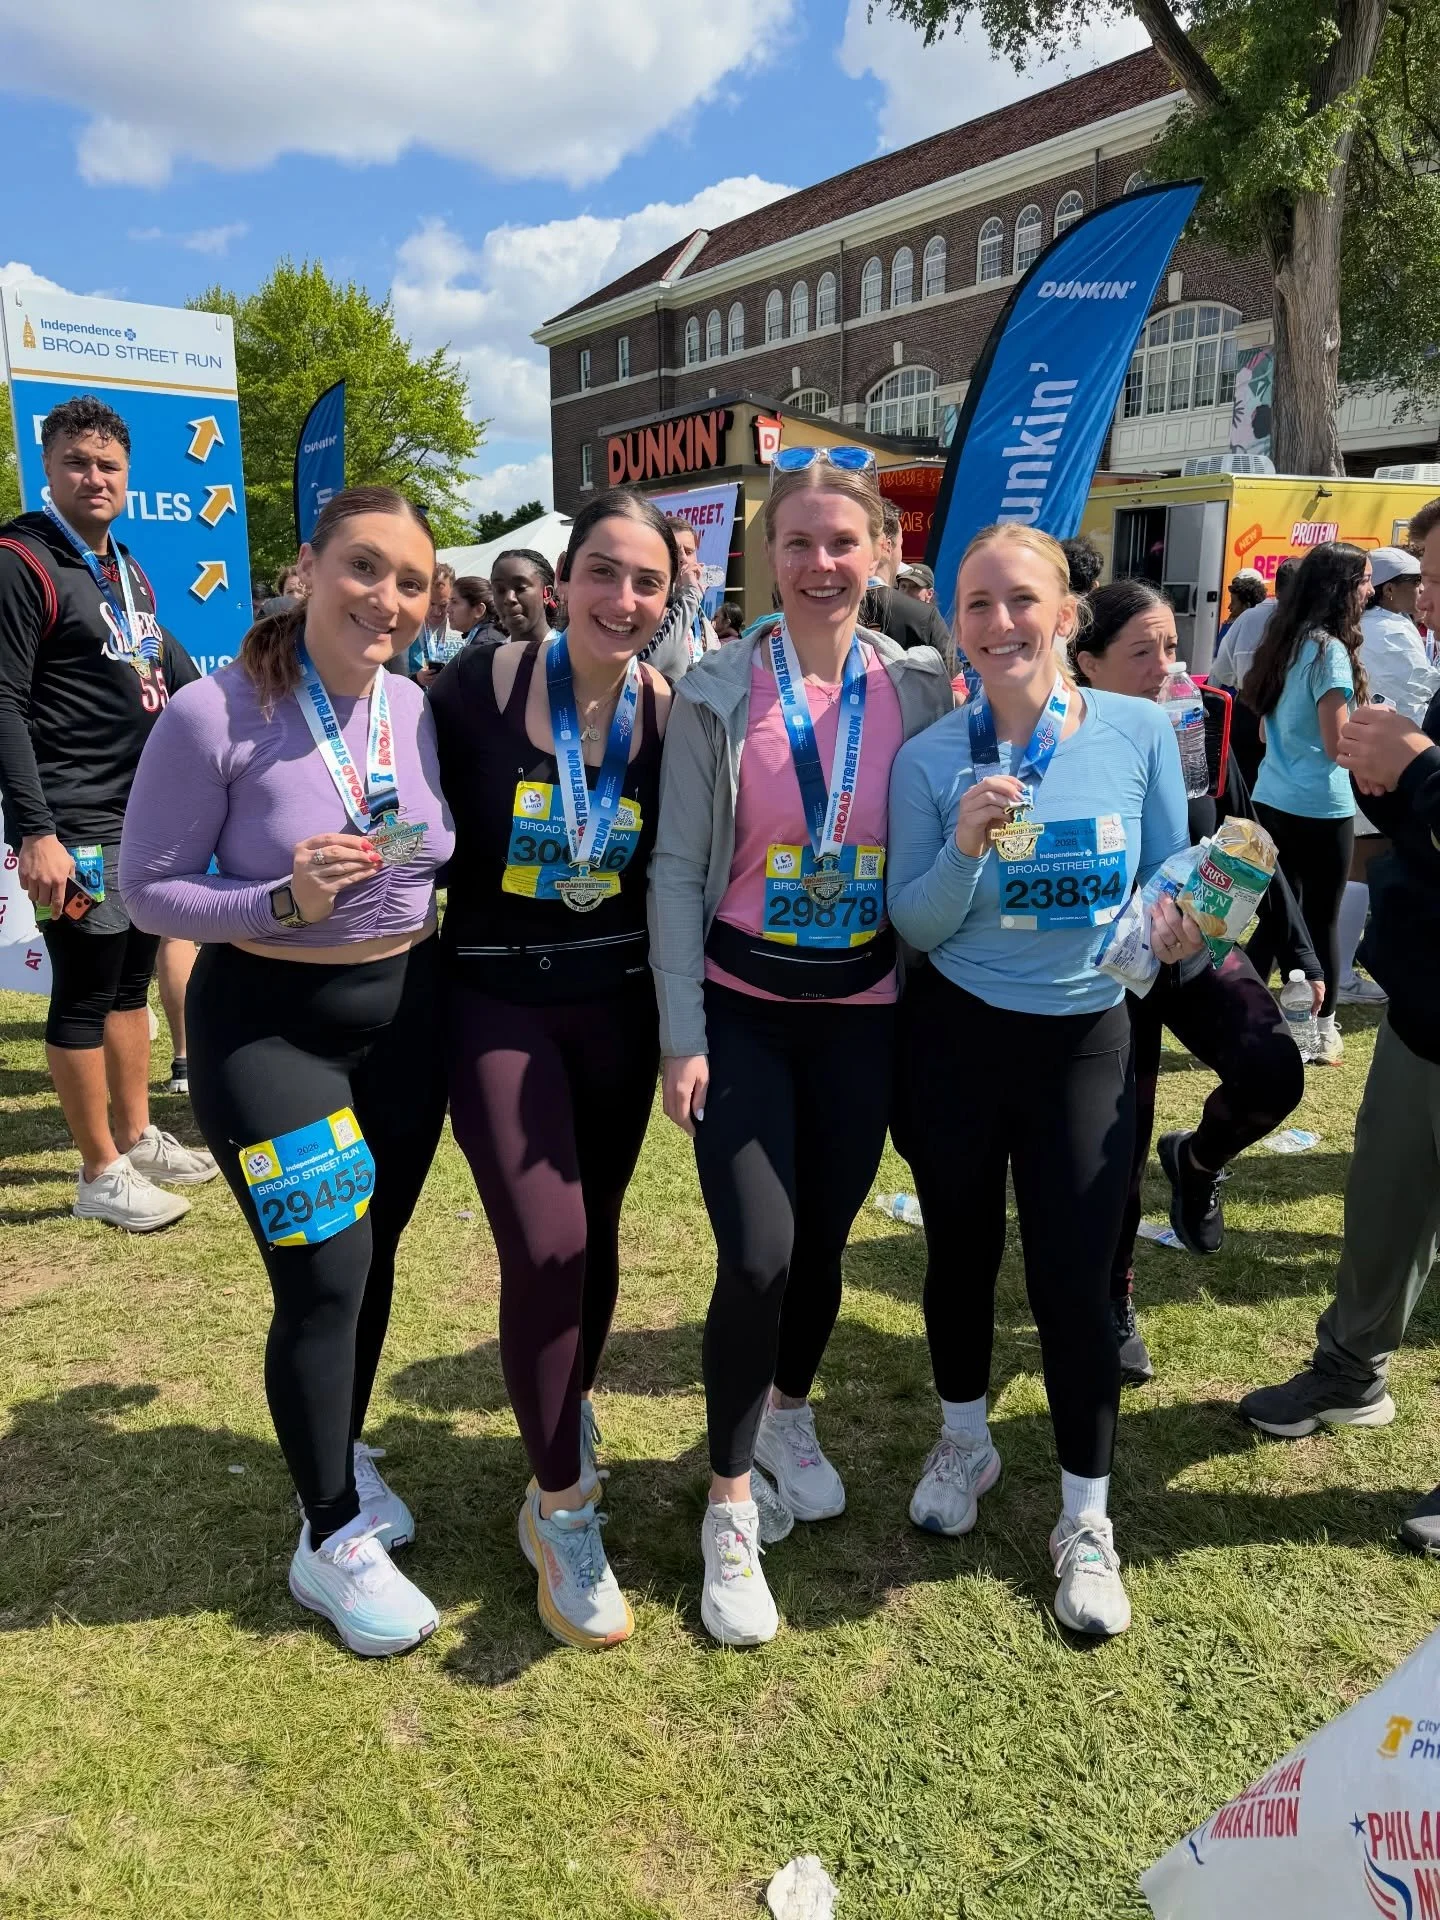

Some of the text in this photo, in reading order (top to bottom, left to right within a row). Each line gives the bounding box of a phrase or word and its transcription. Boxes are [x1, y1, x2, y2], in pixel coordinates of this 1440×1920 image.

[1037, 281, 1136, 300] DUNKIN'
[40, 318, 122, 337] Independence
[42, 337, 222, 369] BROAD STREET RUN
[608, 409, 729, 486] DUNKIN'
[764, 433, 775, 450] D
[997, 362, 1079, 527] unkin'
[41, 485, 192, 521] STLES
[1238, 529, 1258, 551] NEW
[1290, 522, 1339, 546] PROTEIN
[833, 714, 862, 844] BROADSTREETRUN
[520, 820, 561, 834] BROAD
[513, 835, 629, 870] 306
[1007, 856, 1120, 875] BROAD STREET RUN
[1040, 850, 1085, 860] Independence
[1202, 860, 1228, 886] ERR'S
[856, 882, 878, 891] RUN
[1005, 870, 1121, 909] 23834
[768, 895, 879, 928] 29878
[285, 1151, 329, 1172] Independence
[297, 1141, 319, 1156] 2026
[257, 1146, 360, 1196] BROAD STREET RUN
[262, 1159, 373, 1234] 29455
[1210, 1796, 1300, 1841] MARATHON
